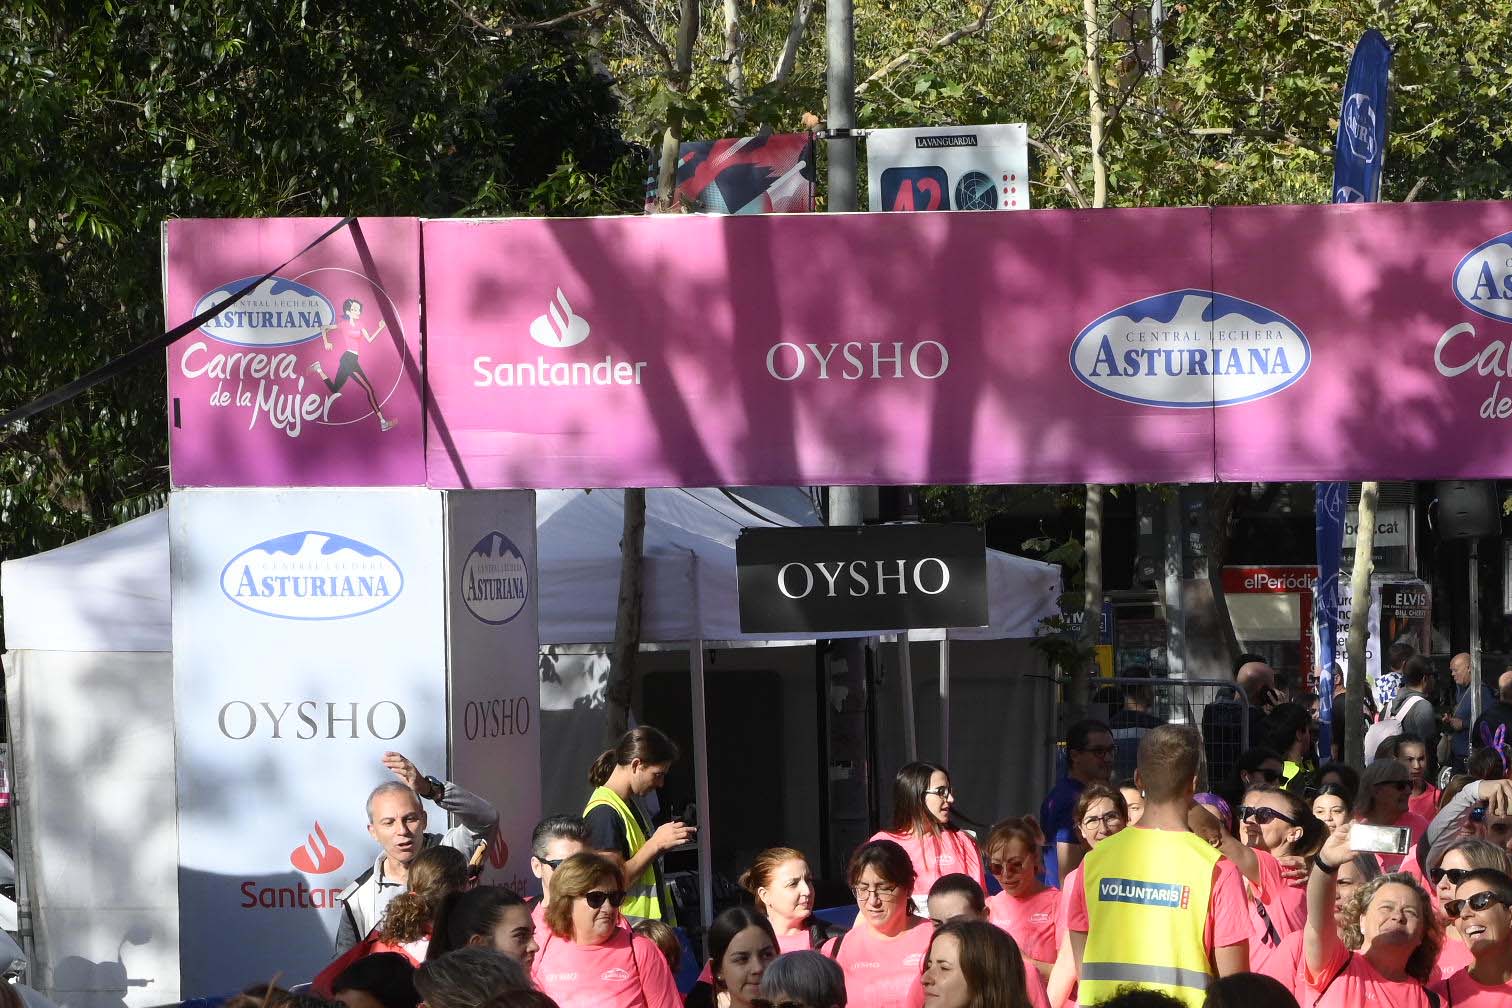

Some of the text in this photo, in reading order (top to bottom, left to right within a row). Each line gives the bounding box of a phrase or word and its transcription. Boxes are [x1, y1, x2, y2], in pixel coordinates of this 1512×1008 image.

[917, 136, 976, 147] LA VANGUARDIA
[206, 301, 323, 330] ASTURIANA
[274, 299, 320, 308] LECHERA
[1125, 329, 1284, 341] CENTRAL LECHERA
[180, 341, 298, 380] Carrera
[473, 355, 648, 387] Santander
[766, 340, 950, 381] OYSHO
[1089, 333, 1292, 378] ASTURIANA
[209, 376, 343, 438] de la Mujer
[1479, 382, 1512, 419] de
[235, 564, 392, 599] ASTURIANA
[467, 570, 525, 603] ASTURIANA
[777, 557, 950, 599] OYSHO
[1395, 593, 1426, 606] ELVIS
[218, 700, 407, 740] OYSHO
[464, 696, 530, 741] OYSHO
[1101, 884, 1179, 902] VOLUNTARIS
